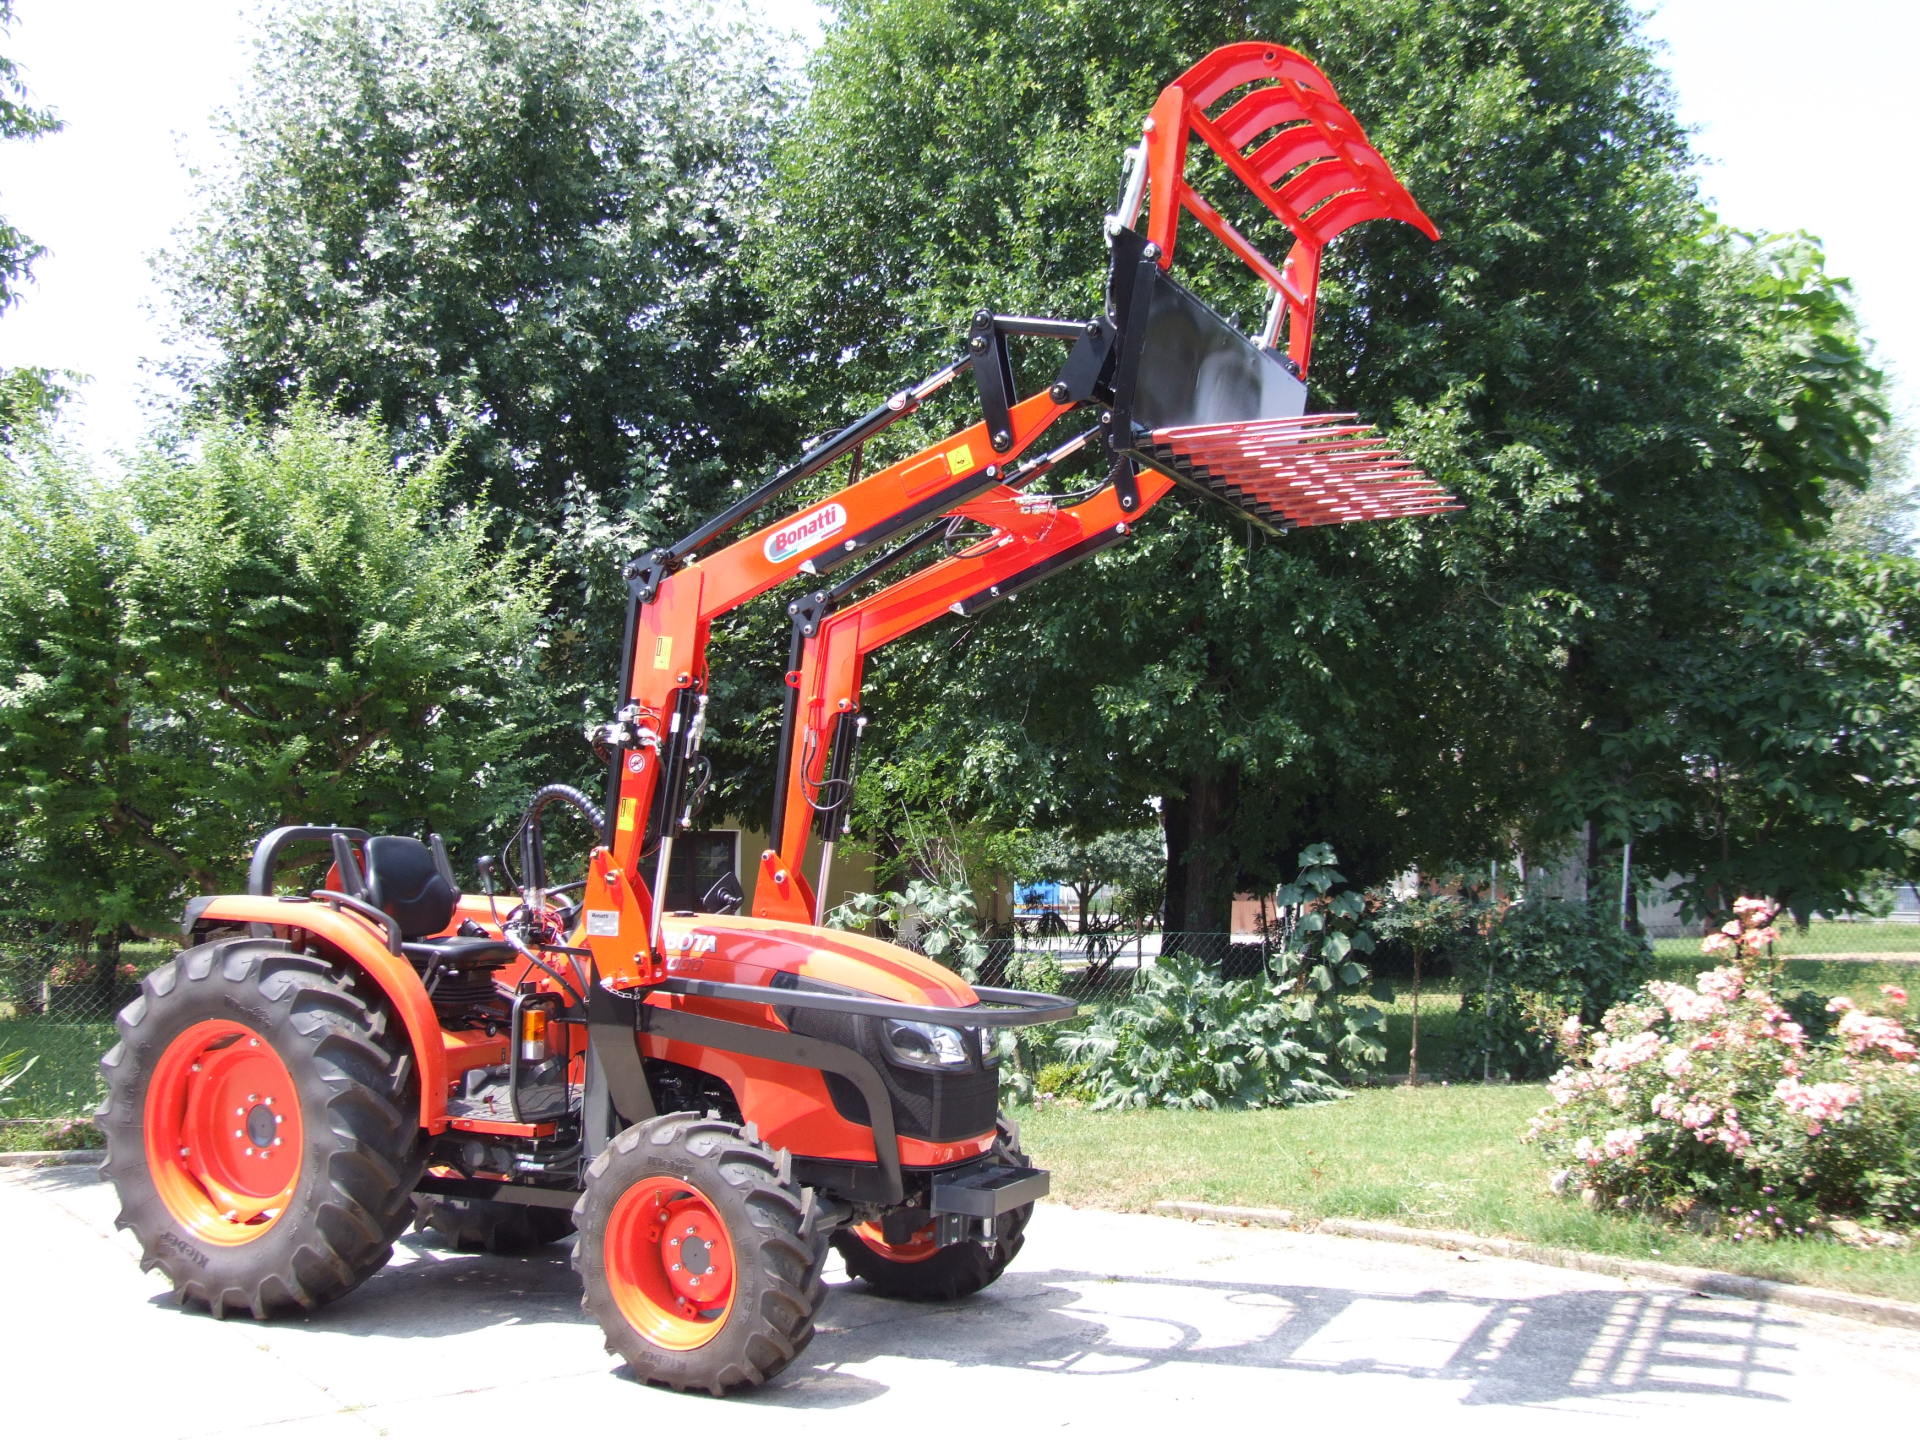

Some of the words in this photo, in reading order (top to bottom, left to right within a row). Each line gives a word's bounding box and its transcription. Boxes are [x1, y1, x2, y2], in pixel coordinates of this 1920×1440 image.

[775, 506, 837, 552] Bonatti
[664, 932, 717, 953] BOTA
[160, 1231, 210, 1269] Kleber
